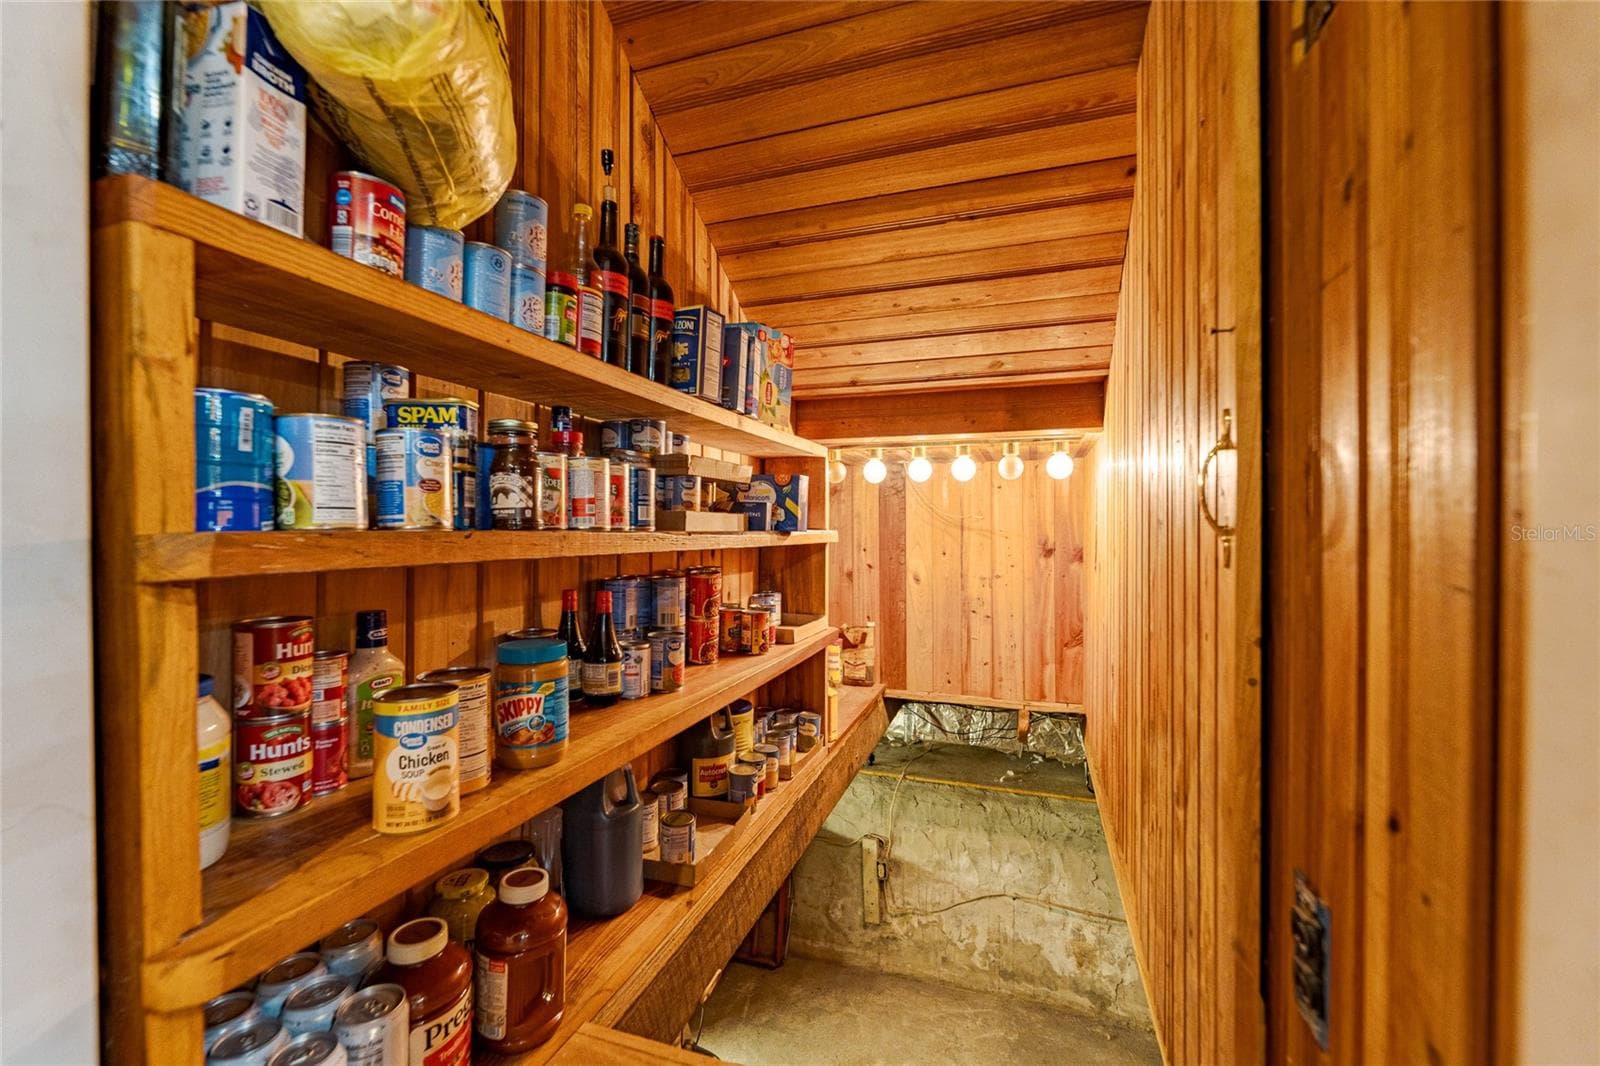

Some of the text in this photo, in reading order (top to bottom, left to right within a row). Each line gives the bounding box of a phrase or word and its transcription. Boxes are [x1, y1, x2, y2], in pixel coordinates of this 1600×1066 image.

[397, 406, 458, 424] SPAM
[398, 703, 433, 713] FAMILY
[496, 696, 542, 725] SKIPPY
[393, 712, 453, 737] CONDENSED
[259, 760, 305, 777] Stewed
[398, 750, 450, 770] Chicken
[401, 768, 425, 779] SOUP
